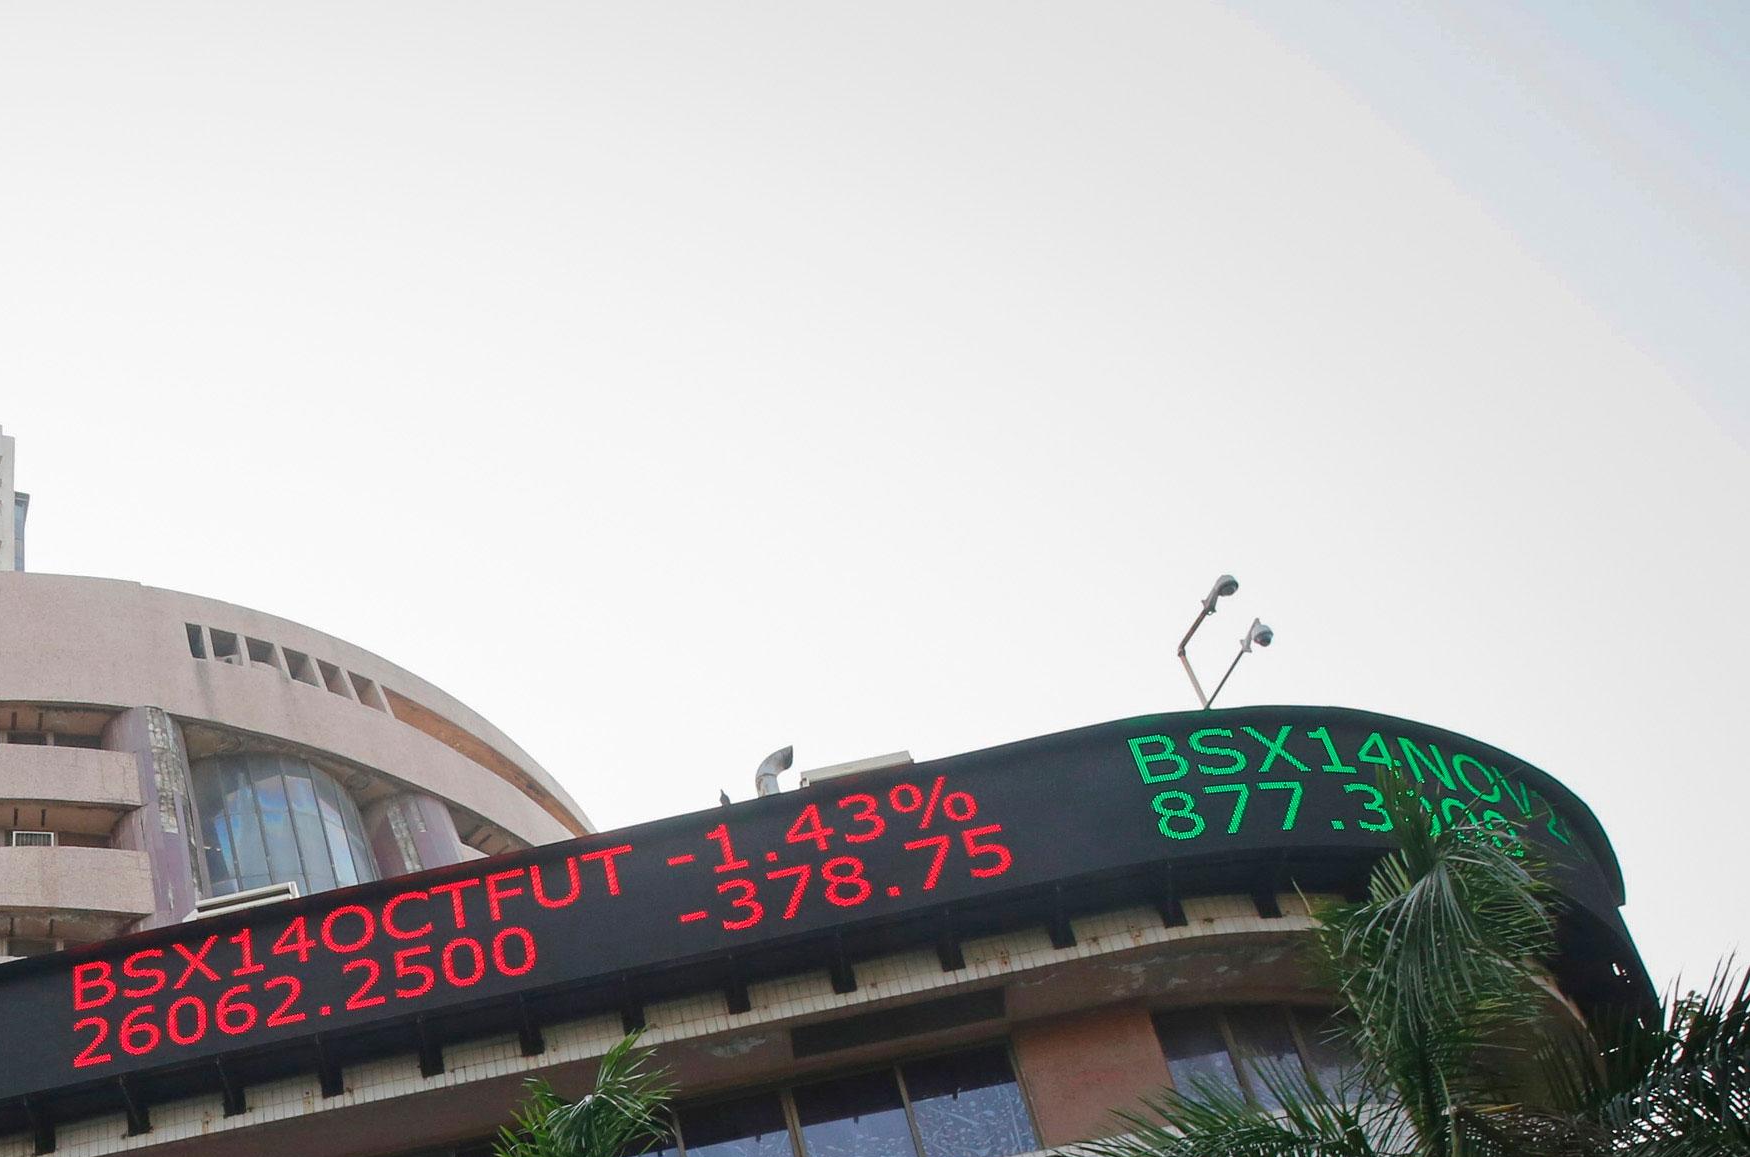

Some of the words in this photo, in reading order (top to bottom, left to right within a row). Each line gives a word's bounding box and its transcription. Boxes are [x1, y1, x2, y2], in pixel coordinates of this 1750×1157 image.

[72, 844, 634, 1012] BSX14OCTFUT
[667, 775, 978, 873] -1.43%
[72, 925, 537, 1068] 26062.2500
[679, 823, 1013, 931] -378.75
